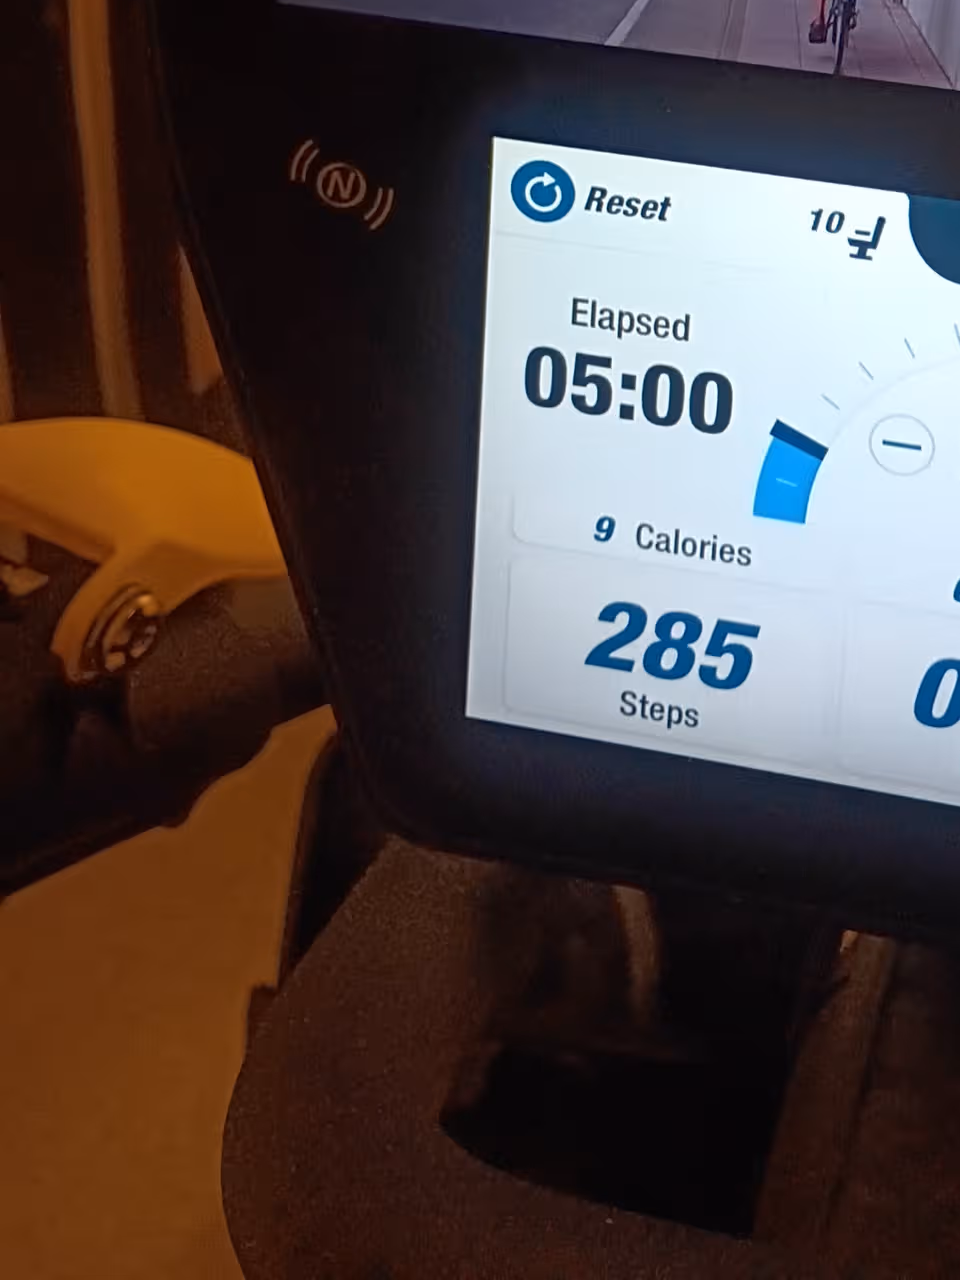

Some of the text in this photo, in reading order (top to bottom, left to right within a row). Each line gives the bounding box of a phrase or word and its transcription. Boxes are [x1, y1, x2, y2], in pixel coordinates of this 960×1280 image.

[584, 186, 672, 222] Reset
[809, 208, 846, 235] 10
[571, 297, 691, 342] Elapsed
[524, 346, 733, 435] 05:00
[593, 516, 752, 567] 9 Calories
[583, 601, 761, 690] 285
[619, 690, 699, 730] Steps
